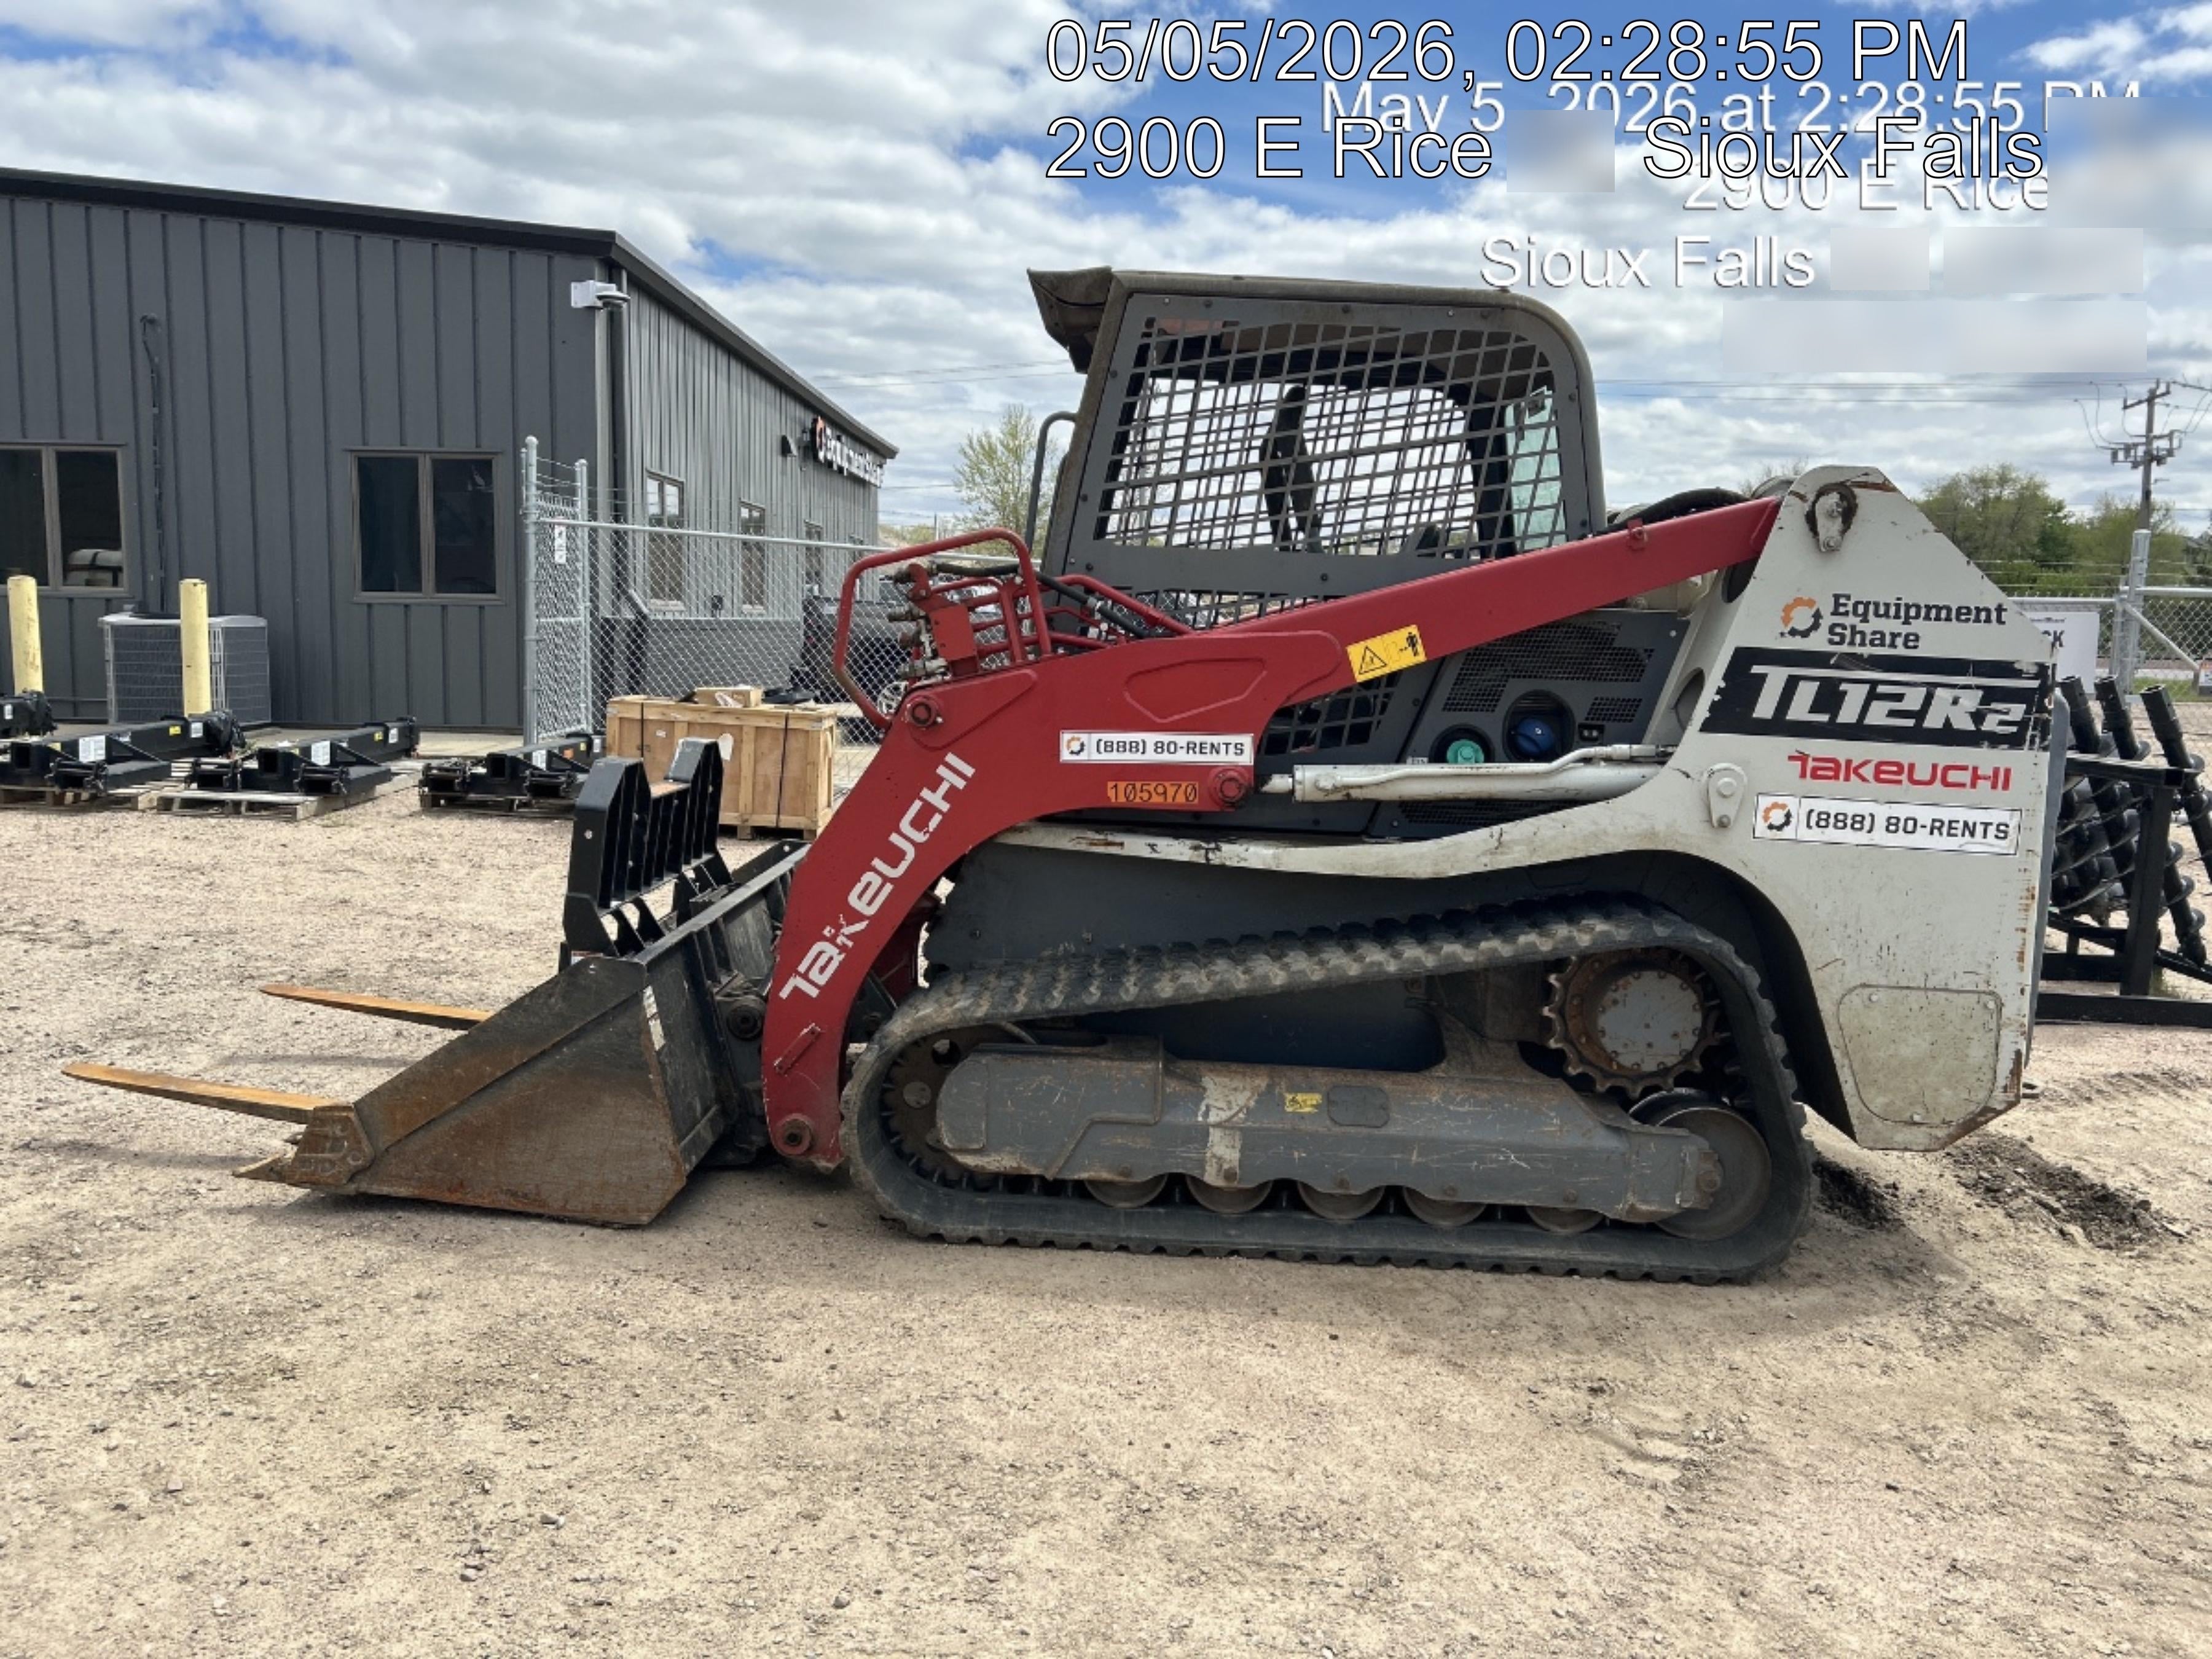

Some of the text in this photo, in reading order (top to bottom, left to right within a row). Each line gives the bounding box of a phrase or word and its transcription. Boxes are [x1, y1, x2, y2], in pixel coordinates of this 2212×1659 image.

[1829, 593, 2008, 626] Equipment
[1827, 622, 1921, 650] Share
[1749, 664, 2041, 735] TL12R2
[1096, 739, 1245, 756] (888) 80-RENTS
[1109, 783, 1198, 802] 105970
[1805, 808, 2010, 841] (888) 80-RENTS
